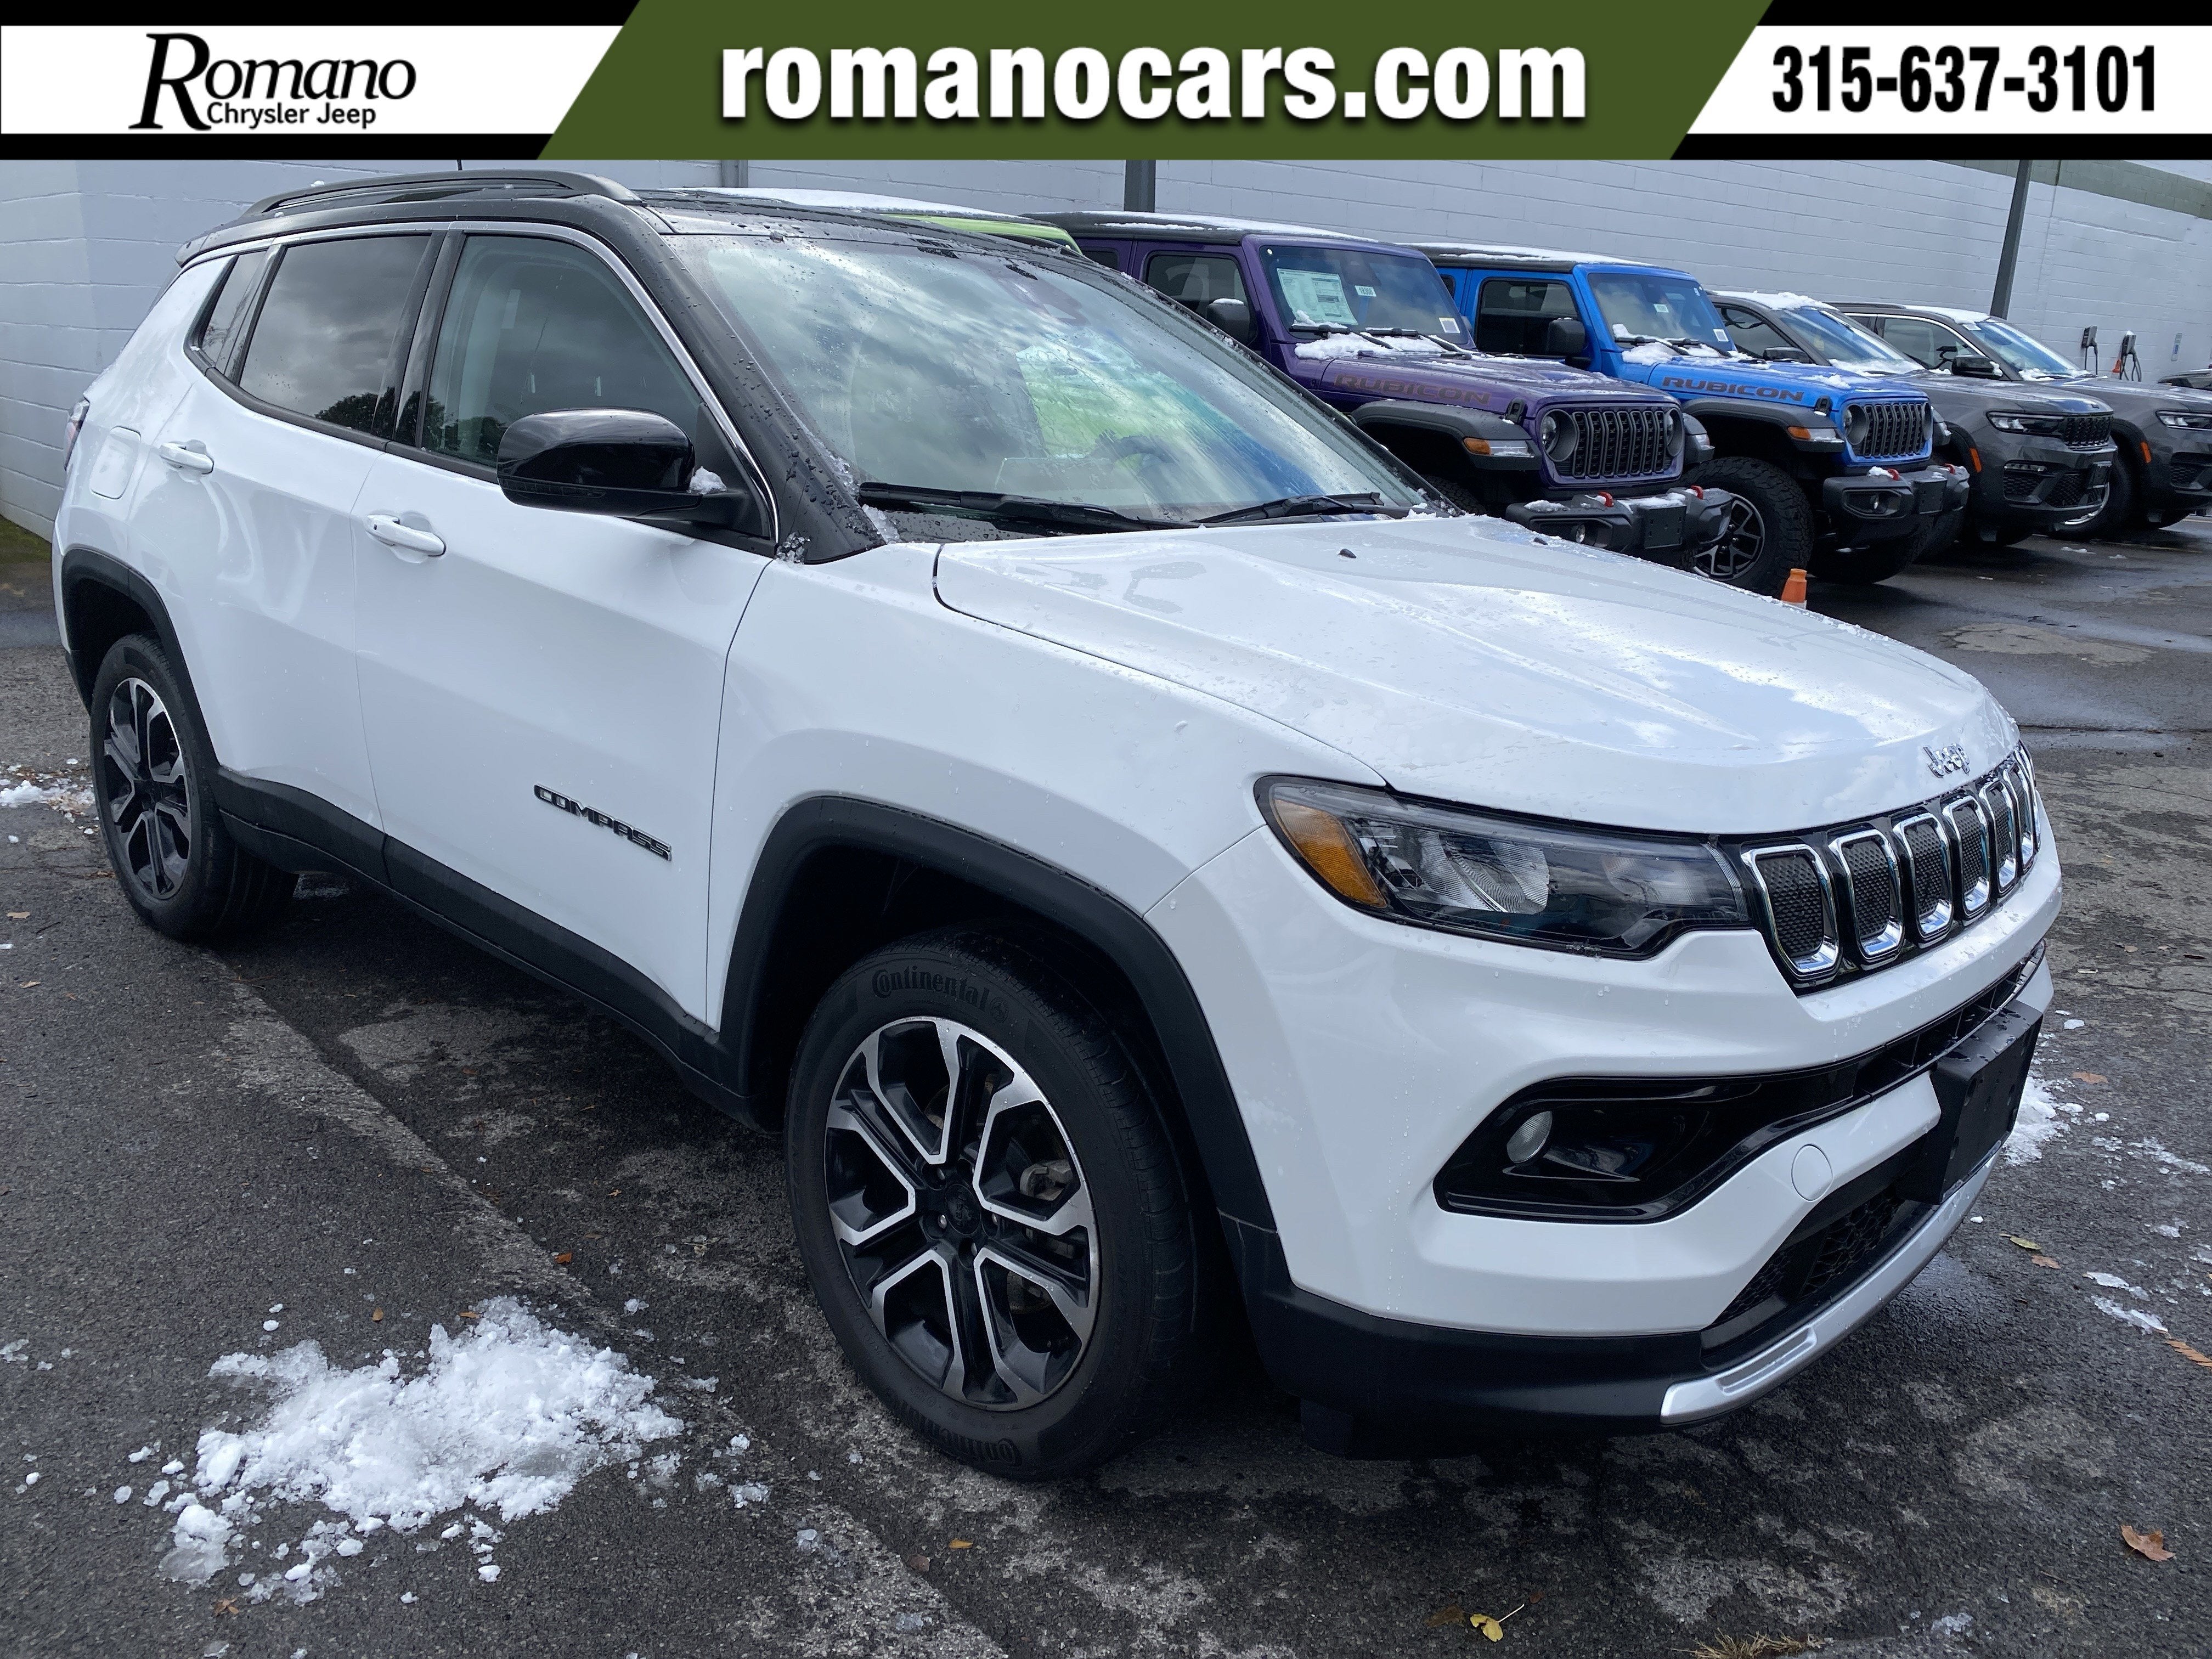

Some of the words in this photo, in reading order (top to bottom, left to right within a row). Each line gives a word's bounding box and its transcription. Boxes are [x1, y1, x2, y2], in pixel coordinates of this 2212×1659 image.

[1334, 374, 1491, 405] RUBICON
[1662, 376, 1804, 402] RUBICON
[1923, 743, 1971, 778] Jeep
[534, 783, 672, 861] COMPASS
[872, 965, 990, 1011] Continental
